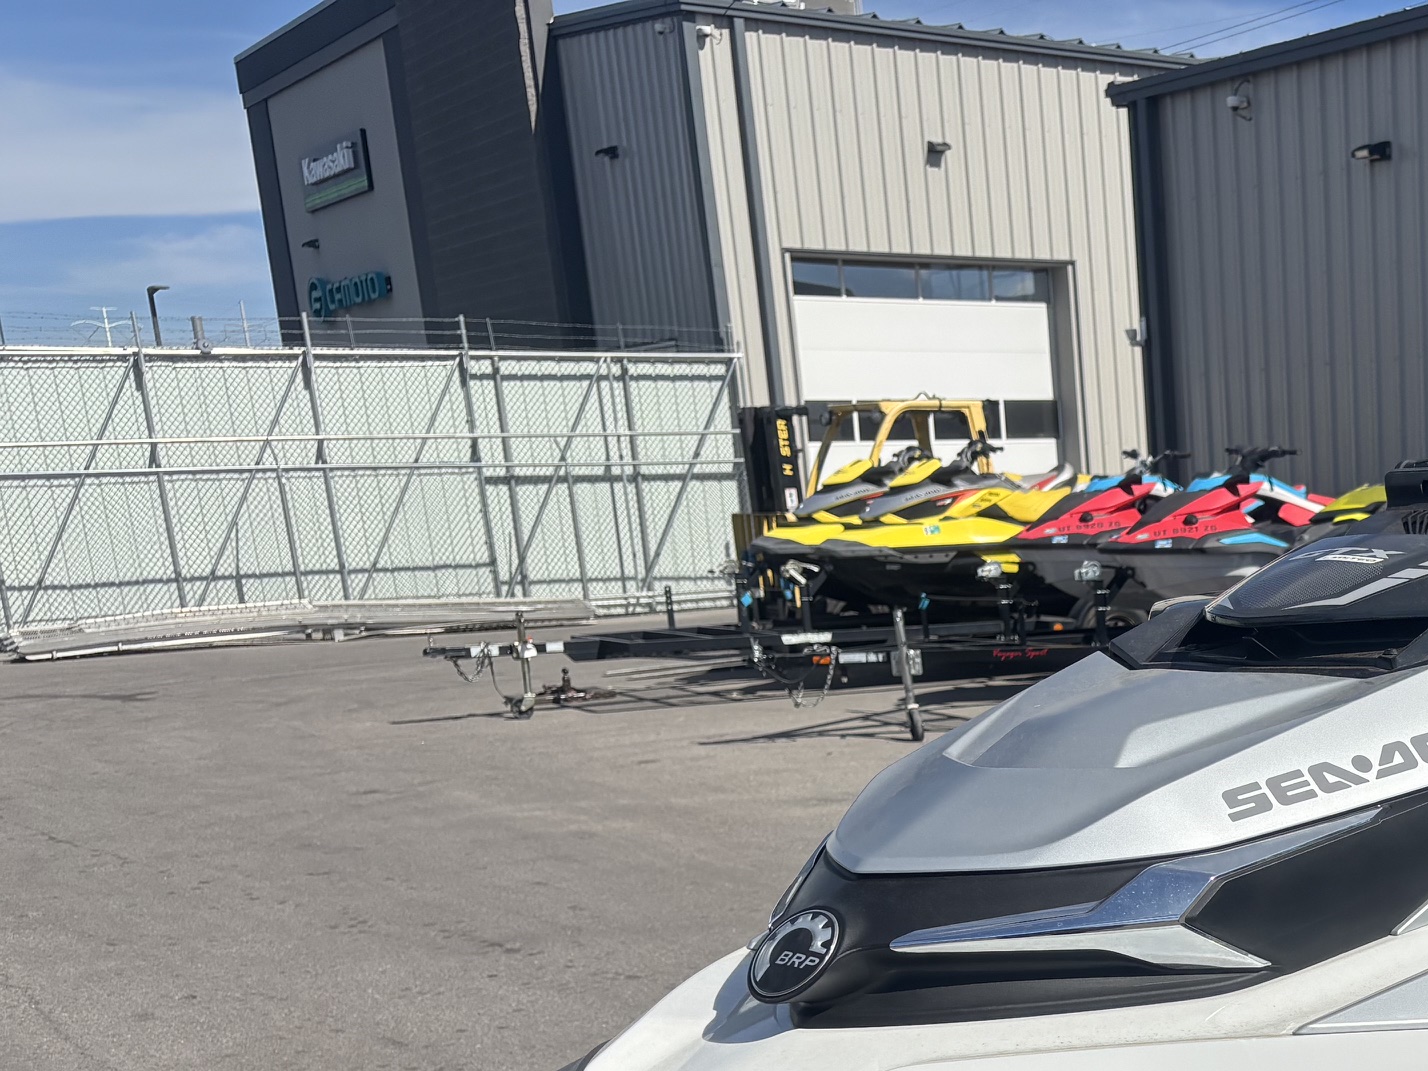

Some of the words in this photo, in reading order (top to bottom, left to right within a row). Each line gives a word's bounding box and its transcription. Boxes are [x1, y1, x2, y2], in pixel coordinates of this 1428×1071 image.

[302, 141, 355, 186] Kawasaki
[776, 418, 794, 476] HSTER
[774, 949, 820, 969] BRP
